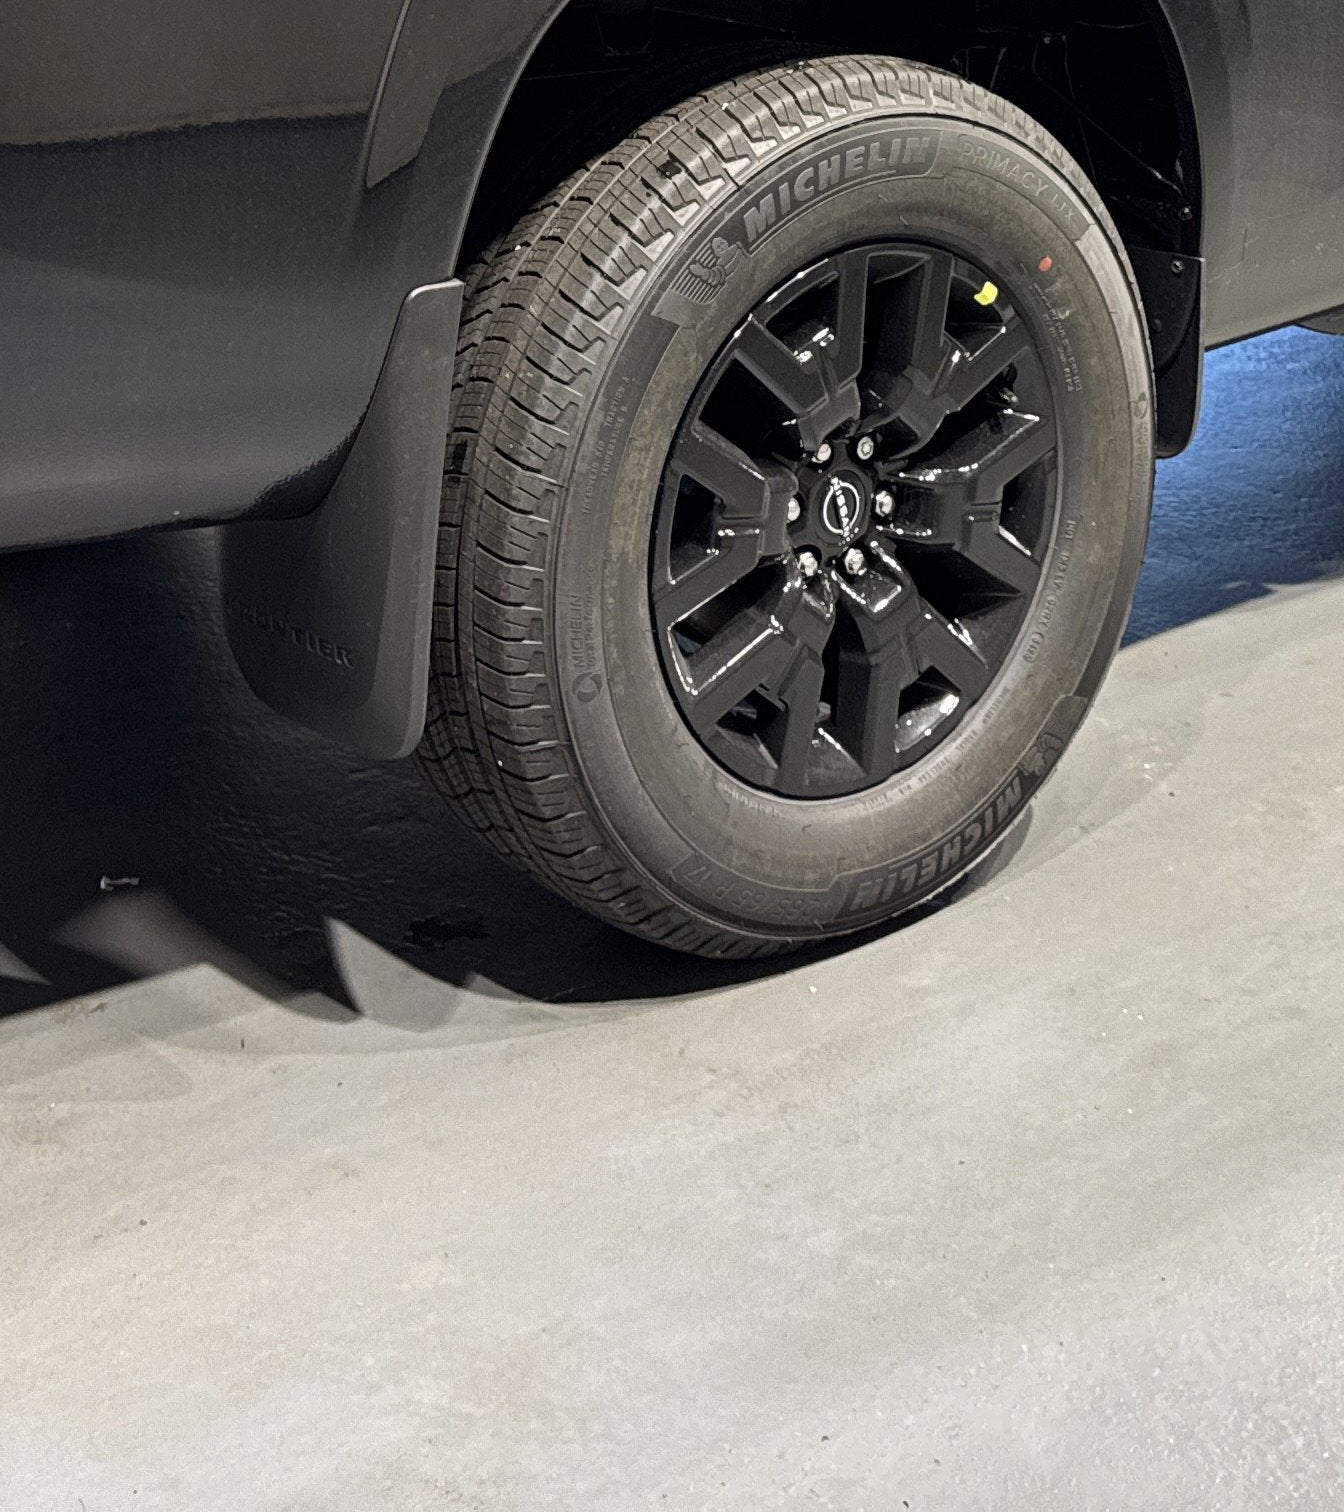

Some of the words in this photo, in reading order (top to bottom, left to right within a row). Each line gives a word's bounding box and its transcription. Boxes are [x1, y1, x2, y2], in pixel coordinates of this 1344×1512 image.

[743, 137, 930, 244] MICHELIN
[958, 141, 1049, 198] PRIMACY
[1050, 192, 1076, 222] LTX
[569, 593, 585, 668] MICHELIN
[850, 775, 1023, 912] MICHELIN
